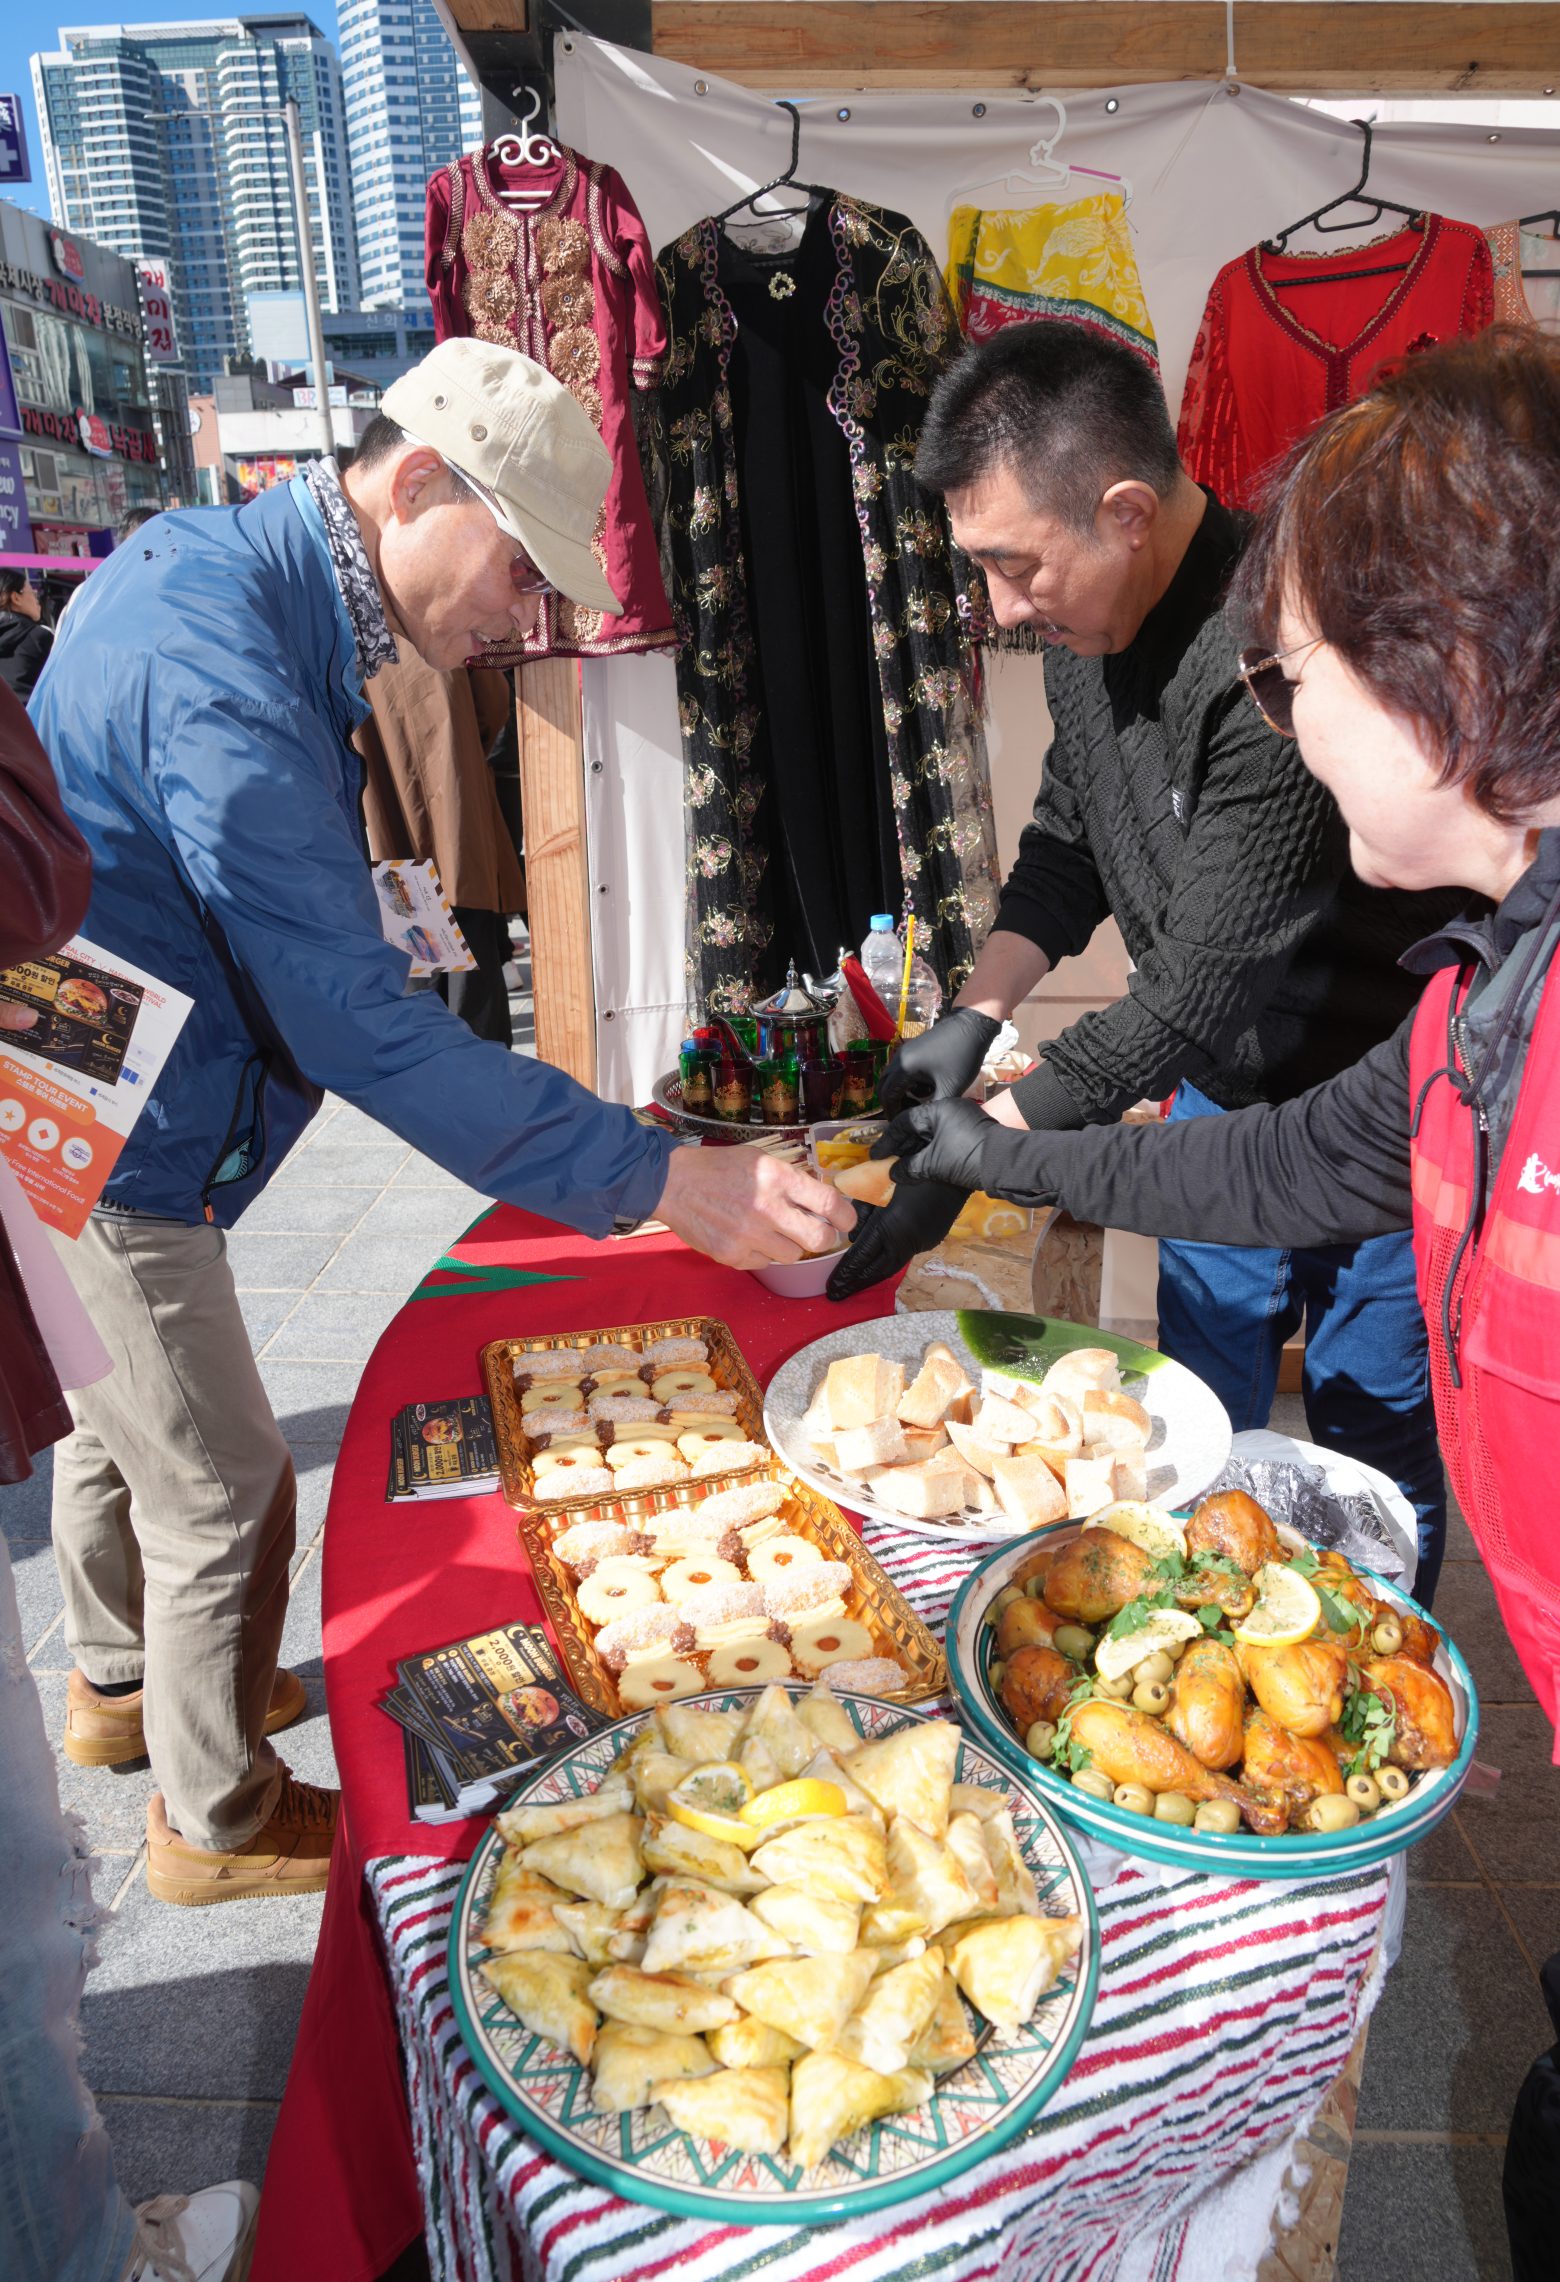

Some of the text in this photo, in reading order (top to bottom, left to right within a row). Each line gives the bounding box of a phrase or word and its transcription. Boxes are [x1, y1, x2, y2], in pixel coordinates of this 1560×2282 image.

[141, 270, 172, 352] 개미집
[79, 951, 96, 963] CITY
[2, 1060, 32, 1081] STAMP
[32, 1077, 58, 1096] TOUR
[57, 1091, 88, 1113] EVENT
[25, 1167, 67, 1194] International
[488, 1638, 516, 1672] 2,000원
[519, 1636, 556, 1681] MOON BURGER
